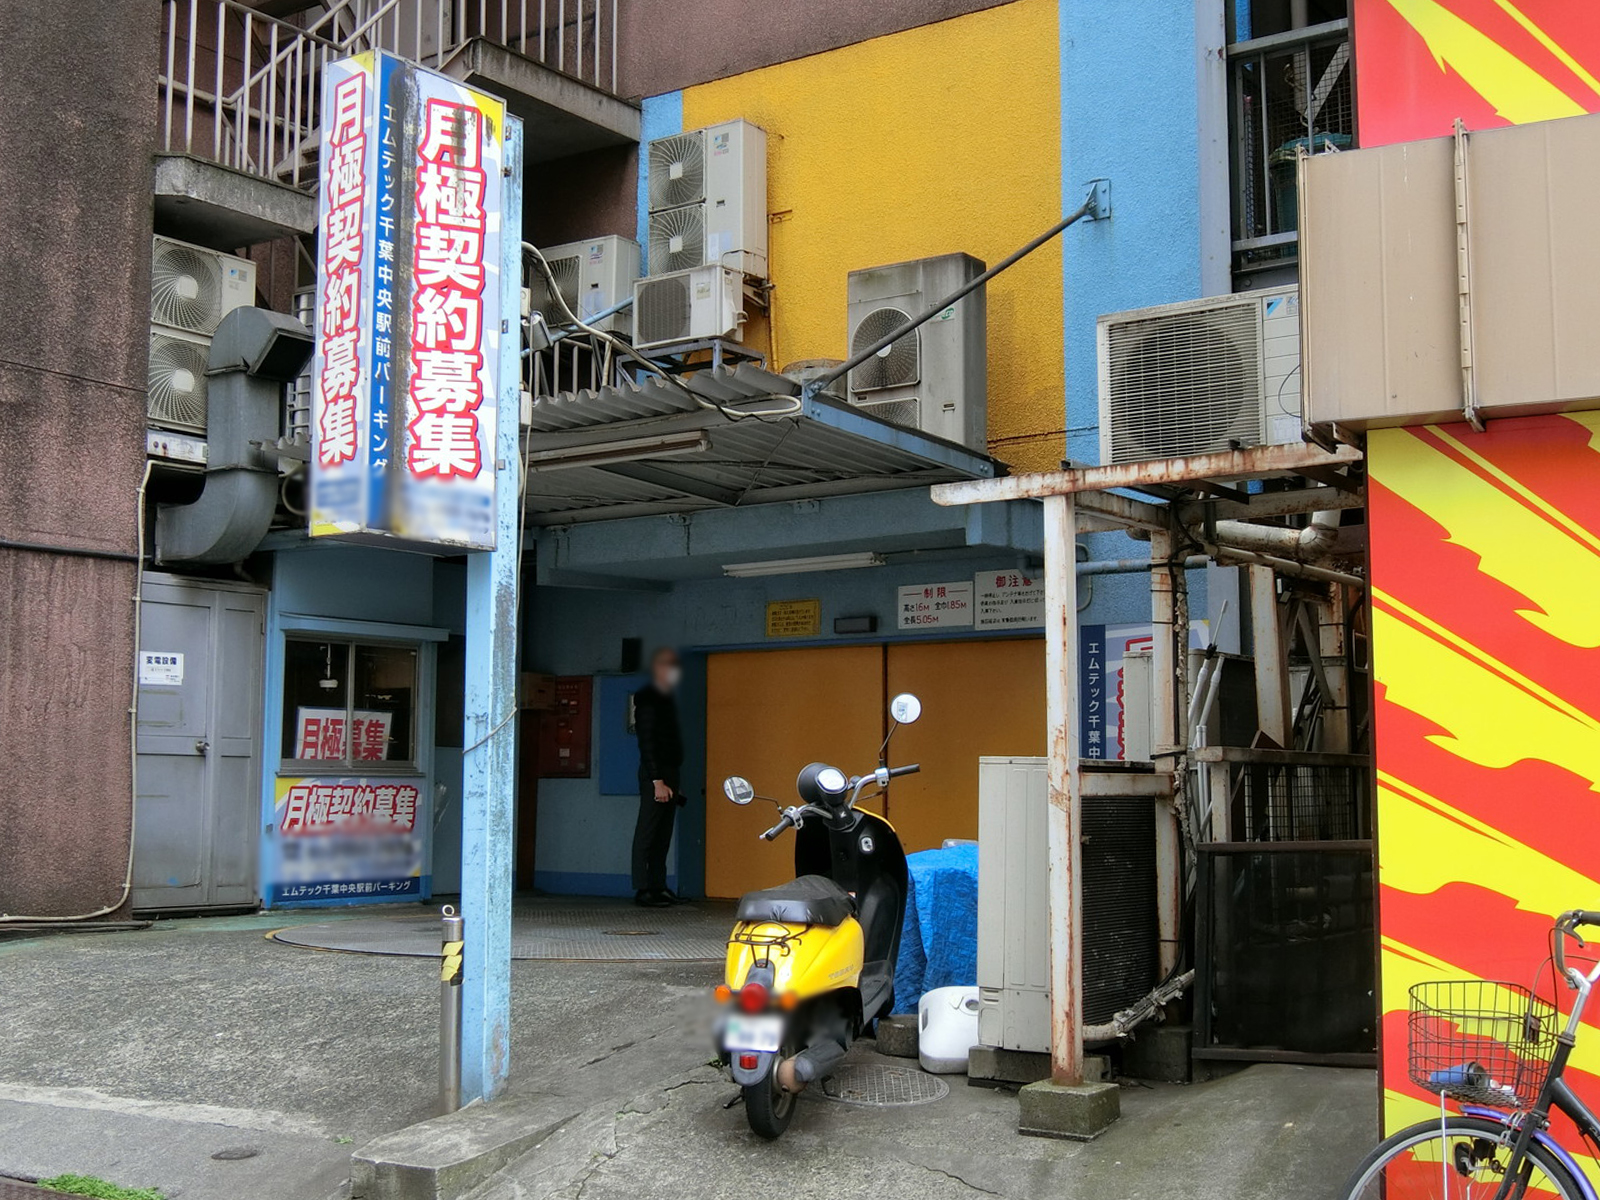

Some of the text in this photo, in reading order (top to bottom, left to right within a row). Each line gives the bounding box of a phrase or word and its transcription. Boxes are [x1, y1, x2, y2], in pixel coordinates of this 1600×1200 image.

[321, 71, 366, 468] 月極契約募集
[373, 103, 397, 473] エムテック千葉中央駅前パーキング
[409, 97, 487, 480] 月極契約募集
[301, 718, 386, 760] 月極募集
[1088, 643, 1101, 759] エムテック千葉中
[282, 785, 419, 832] 月極契約募集
[282, 880, 412, 897] エムテック千葉中央駅前パーキング
